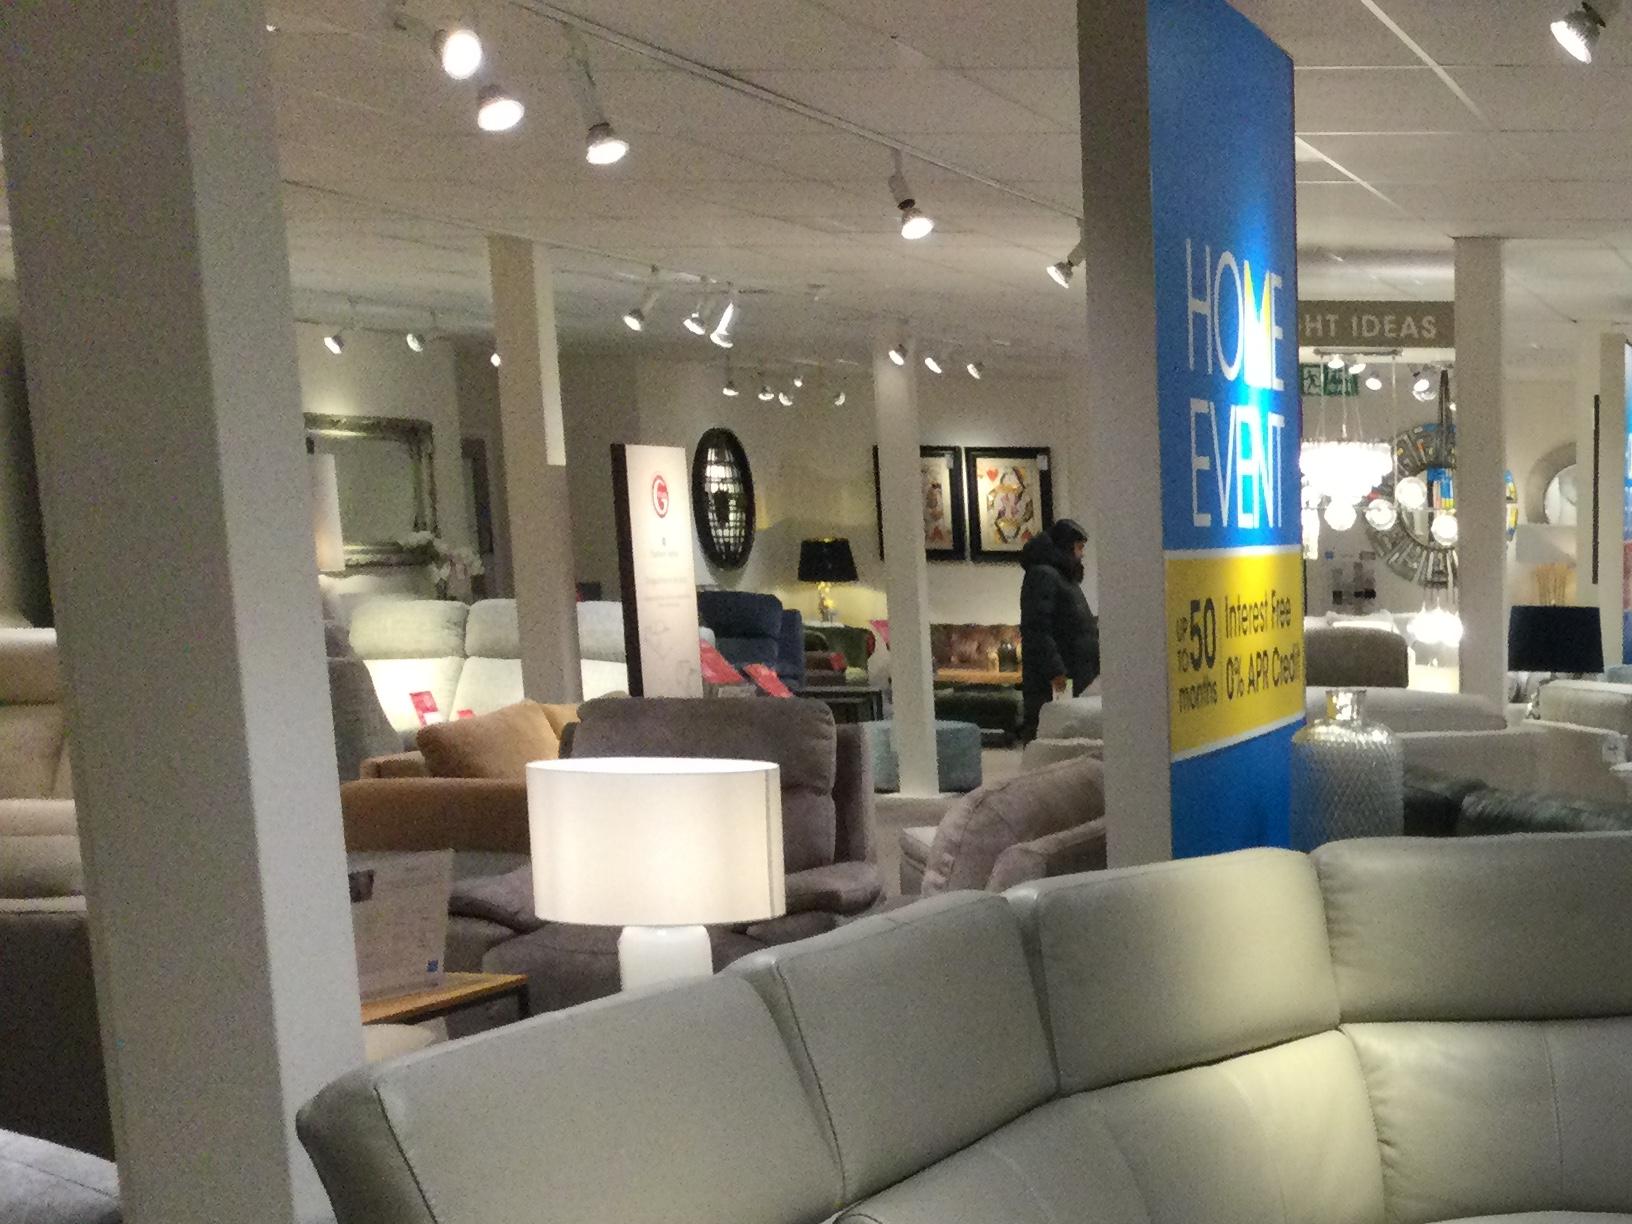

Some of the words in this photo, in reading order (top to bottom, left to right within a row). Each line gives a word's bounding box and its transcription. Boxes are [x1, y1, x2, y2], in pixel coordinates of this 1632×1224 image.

[1186, 238, 1284, 391] HOME
[1301, 314, 1339, 339] HT
[1352, 315, 1436, 339] IDEAS
[1190, 398, 1285, 528] EVENT
[1190, 597, 1217, 671] 50
[1225, 591, 1268, 638] Interest
[1271, 590, 1292, 628] Free
[1226, 656, 1244, 700] 0%
[1248, 650, 1269, 694] APR
